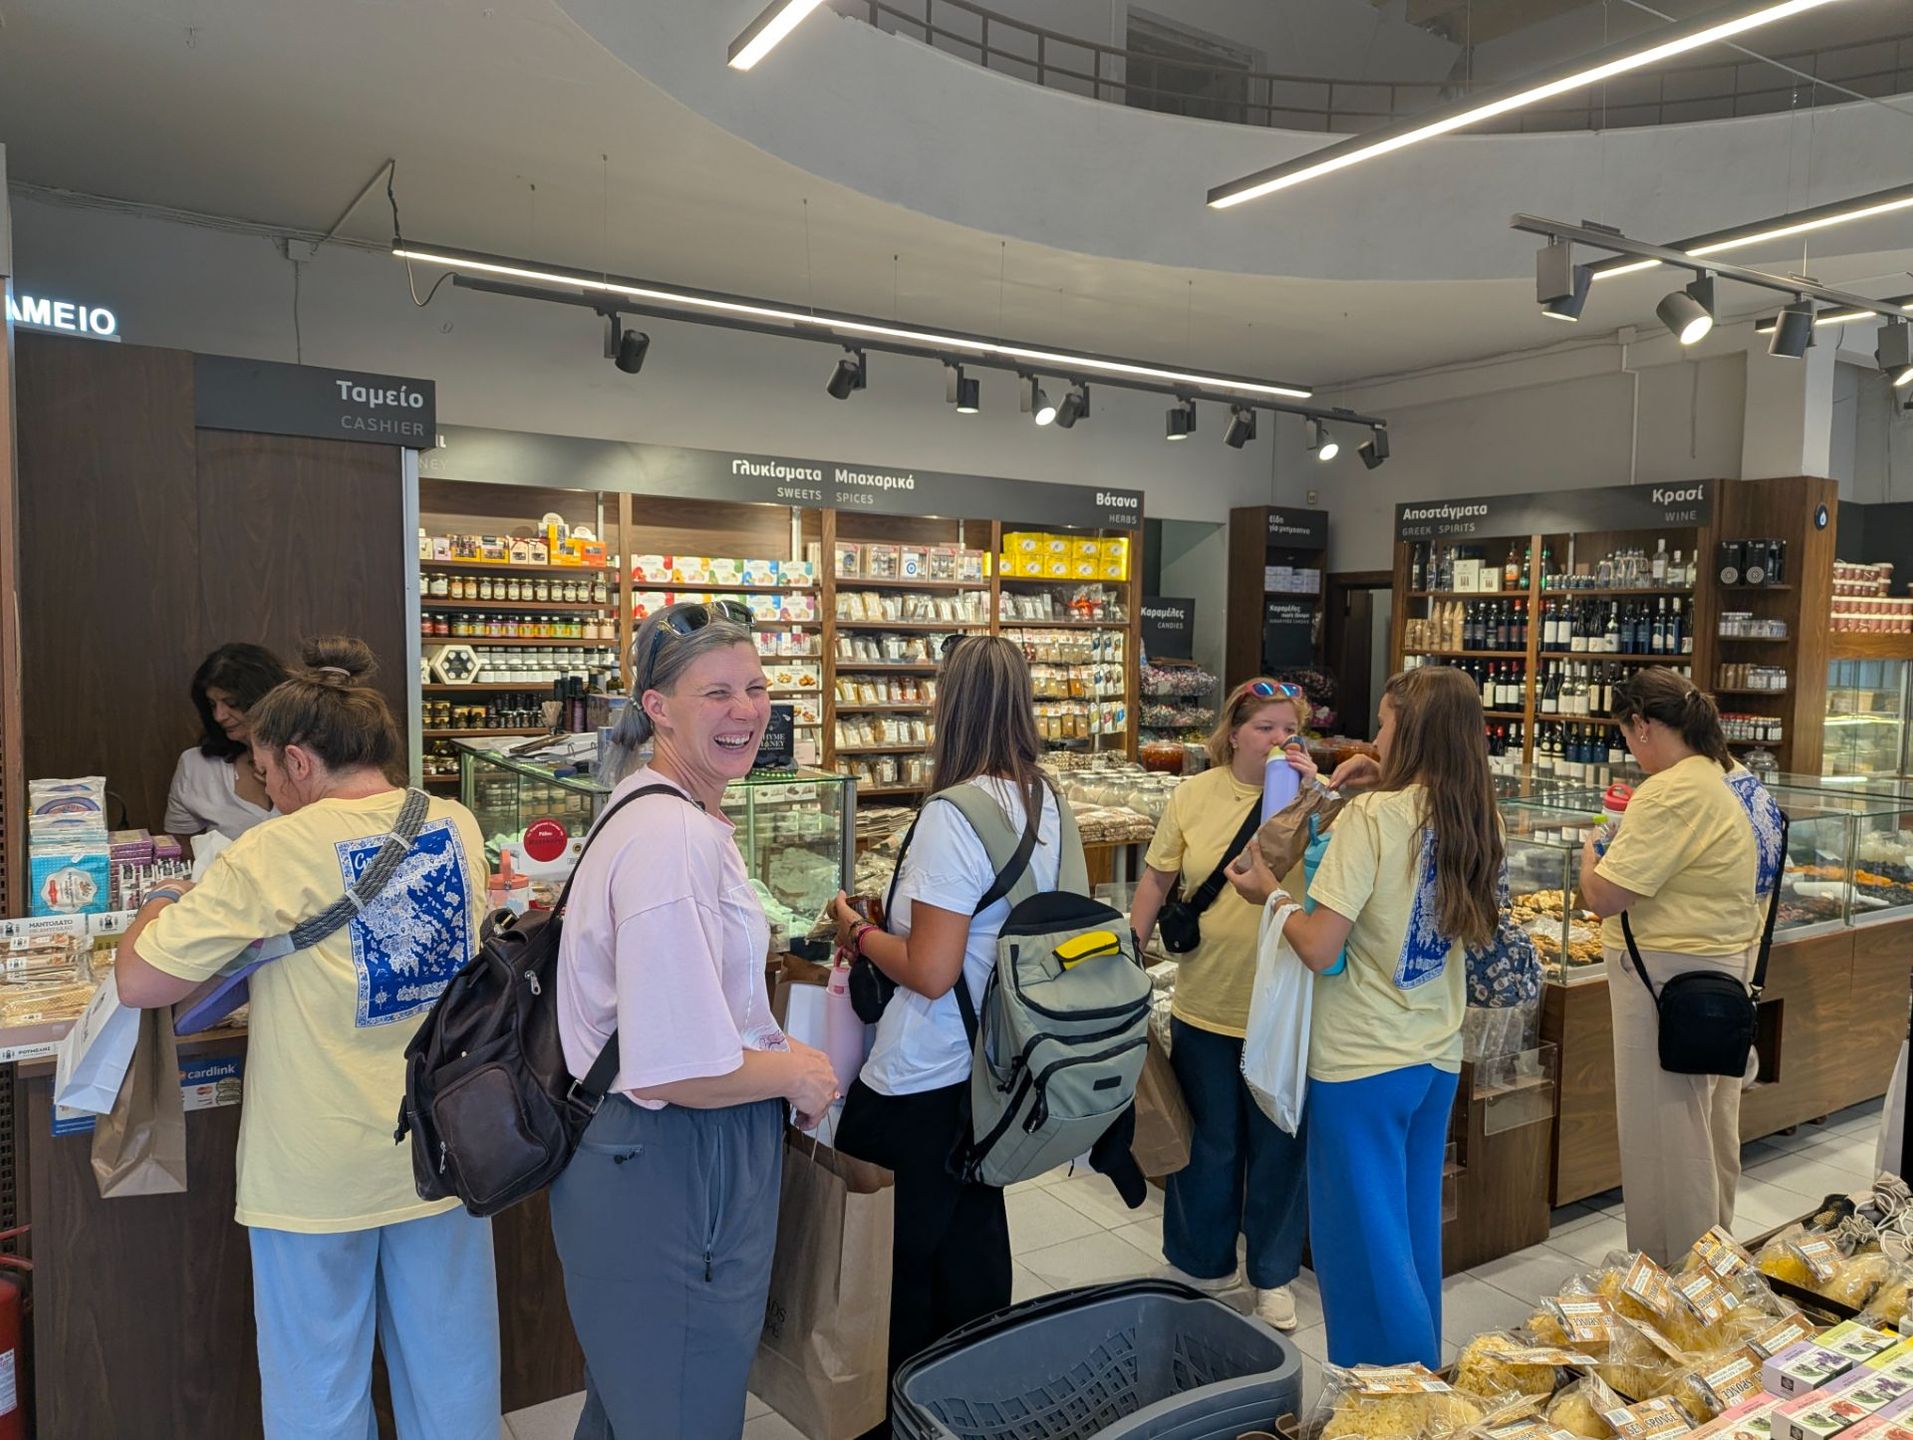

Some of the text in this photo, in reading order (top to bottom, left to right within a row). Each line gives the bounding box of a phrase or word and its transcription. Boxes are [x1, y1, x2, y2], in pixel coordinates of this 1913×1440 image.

[336, 380, 424, 408] Ταμείο
[341, 415, 424, 436] CASHIER
[419, 458, 448, 470] NEY
[732, 460, 915, 490] Γλυκίσματα Μπαχαρικά
[777, 487, 874, 504] SWEETS SPICES
[1096, 492, 1138, 508] Βότανα
[1652, 484, 1703, 506] Κρασί
[1109, 514, 1137, 524] HERBS
[1403, 504, 1488, 520] Αποστάγματα
[1665, 510, 1697, 522] WINE
[1402, 522, 1476, 536] GREEK SPIRITS
[1140, 606, 1184, 620] Καραμέλες
[1157, 622, 1184, 630] CANDIES
[187, 1064, 236, 1080] cardlink
[1722, 1377, 1754, 1399] SPONGE
[1644, 1412, 1679, 1429] SPONGE
